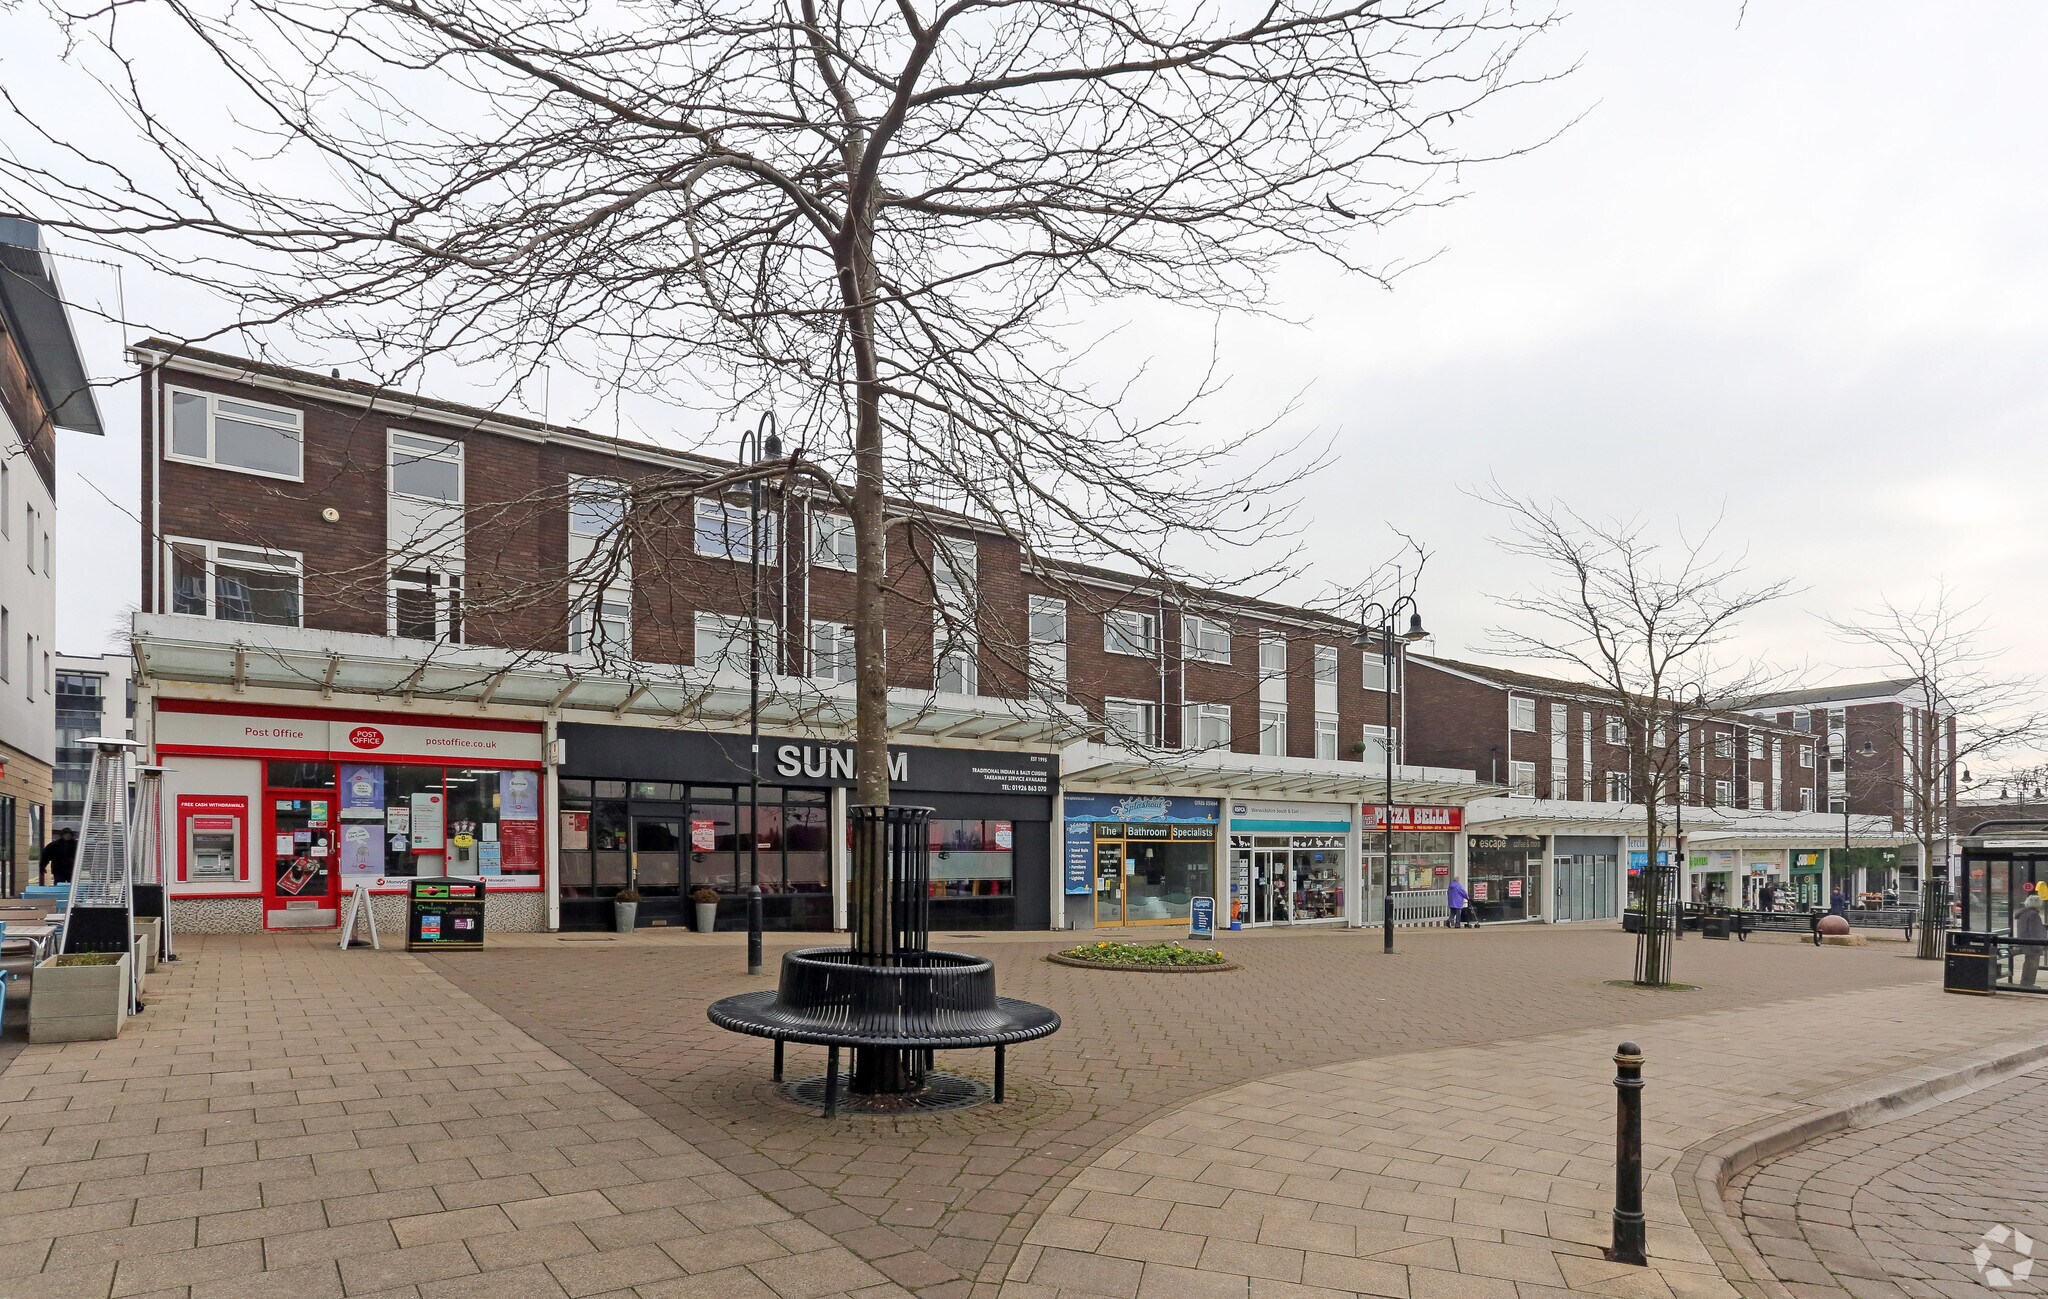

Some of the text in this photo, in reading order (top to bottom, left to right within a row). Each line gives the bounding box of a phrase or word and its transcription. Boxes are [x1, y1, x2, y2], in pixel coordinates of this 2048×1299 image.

[245, 727, 304, 739] Post Office
[356, 730, 378, 738] POST
[352, 737, 381, 745] OFFICE
[425, 737, 497, 749] postoffice.co.uk
[777, 744, 908, 782] SUNM
[972, 767, 1000, 775] TRADITIONAL
[1123, 800, 1162, 814] Splashout
[1413, 808, 1450, 825] BELLA
[1100, 826, 1213, 839] The Bathroom Specialists
[1479, 839, 1507, 851] escape
[1513, 840, 1527, 848] coffee
